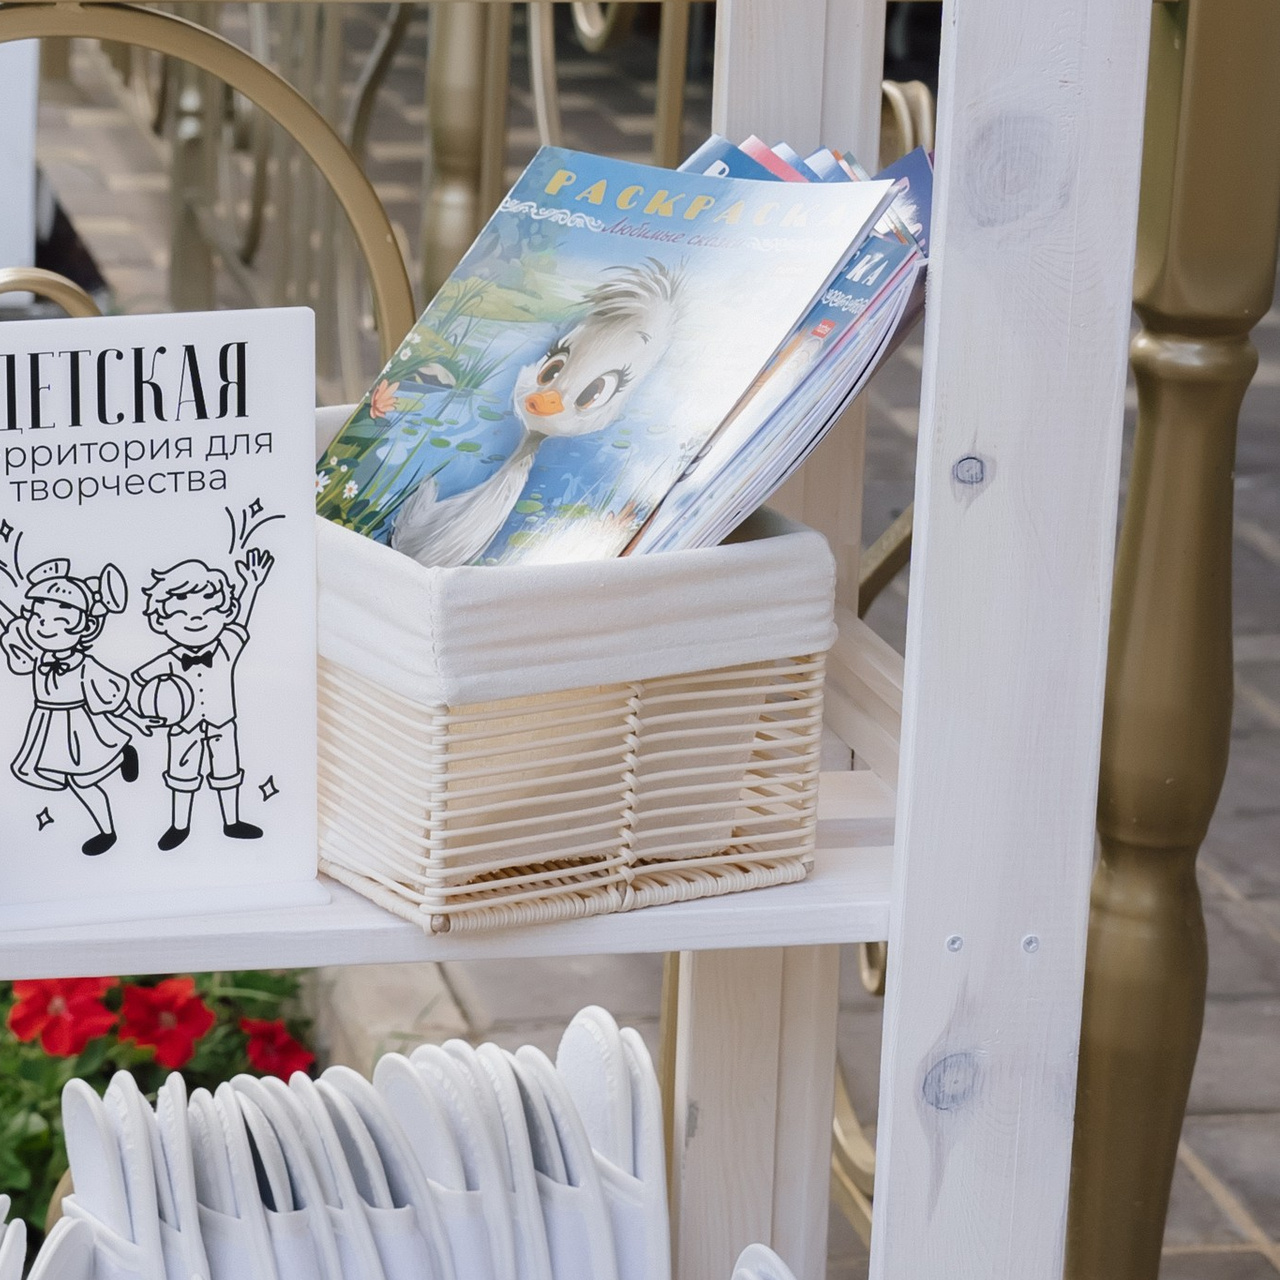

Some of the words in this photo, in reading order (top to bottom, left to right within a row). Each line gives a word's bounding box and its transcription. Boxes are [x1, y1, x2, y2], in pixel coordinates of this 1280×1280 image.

[544, 168, 848, 228] РАСКРАСКА
[601, 215, 686, 244] Любимые
[205, 431, 274, 463] для
[9, 468, 228, 505] творчества
